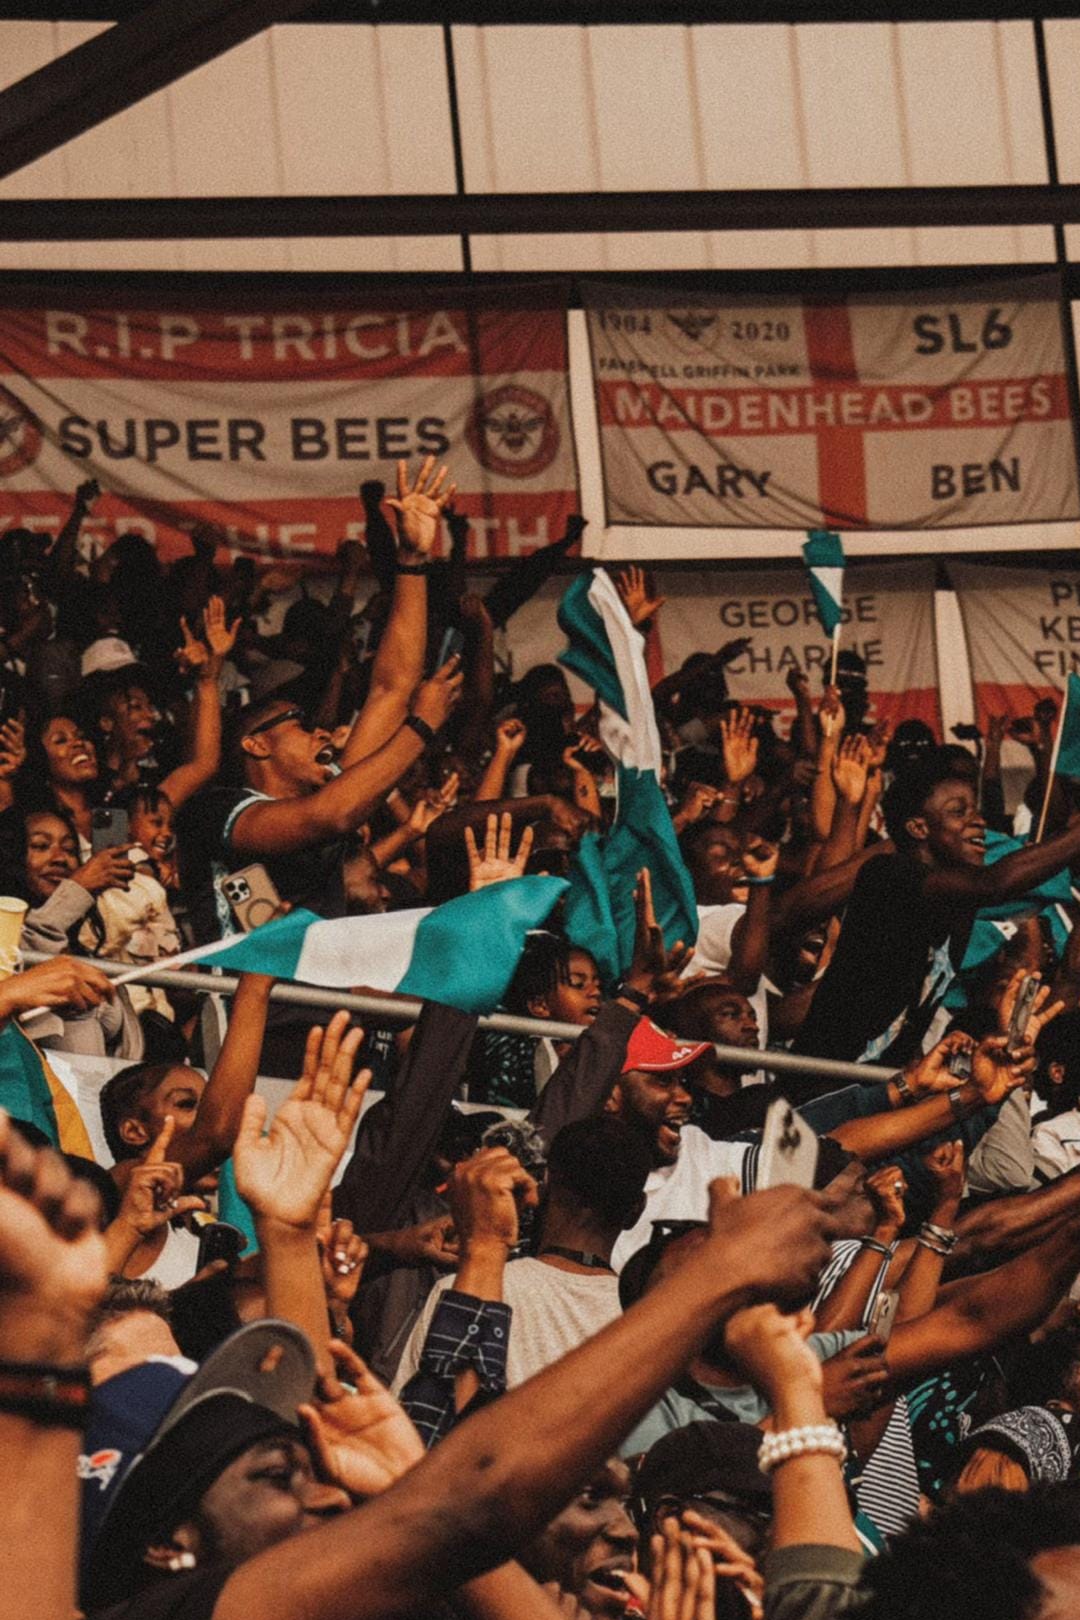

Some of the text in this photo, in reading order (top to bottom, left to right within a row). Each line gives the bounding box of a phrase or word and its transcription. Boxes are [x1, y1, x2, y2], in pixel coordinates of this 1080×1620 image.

[45, 310, 468, 361] R.I.P TRICIA
[731, 321, 790, 341] 2020
[913, 308, 1013, 355] SL6
[613, 381, 1052, 431] MAIDENHEAD BEES
[58, 416, 451, 461] SUPER BEES
[645, 460, 772, 499] GARY
[930, 457, 1021, 500] BEN
